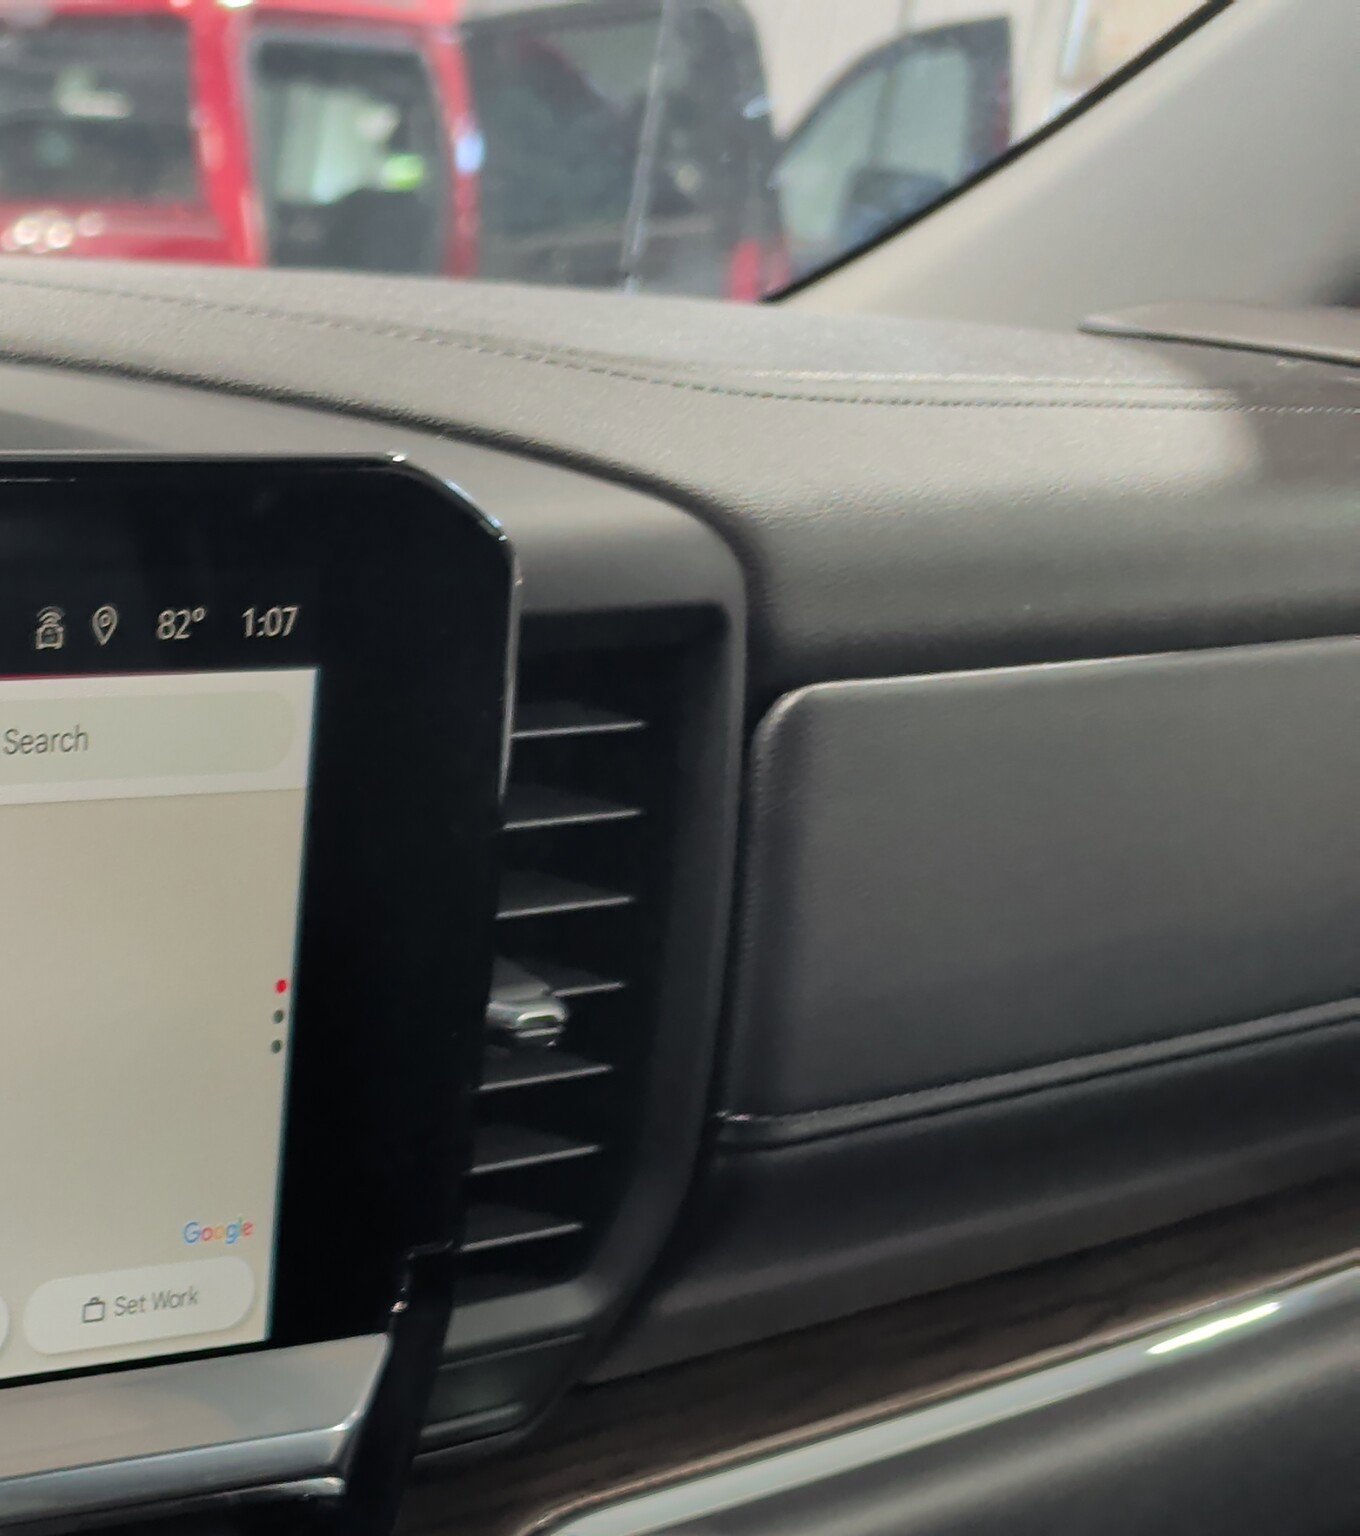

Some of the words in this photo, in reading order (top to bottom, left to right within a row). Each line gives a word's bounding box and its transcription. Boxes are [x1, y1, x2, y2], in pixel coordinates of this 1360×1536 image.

[241, 606, 299, 640] 1:07
[2, 725, 90, 757] Search
[184, 1219, 253, 1244] Google
[113, 1294, 147, 1319] Set
[149, 1285, 200, 1313] Work
